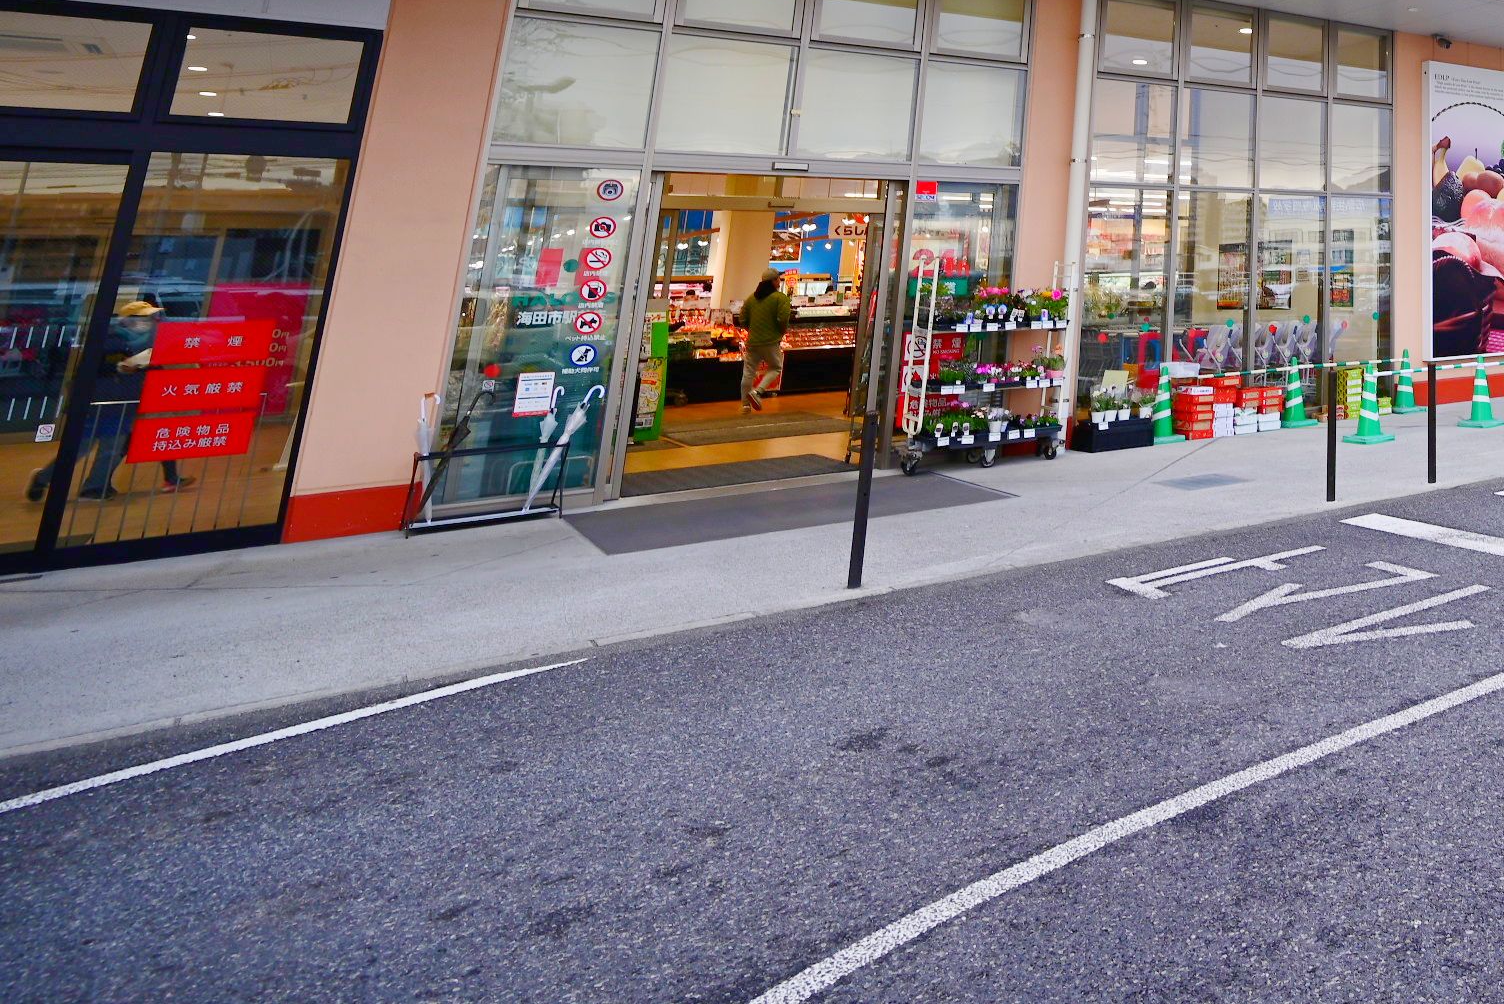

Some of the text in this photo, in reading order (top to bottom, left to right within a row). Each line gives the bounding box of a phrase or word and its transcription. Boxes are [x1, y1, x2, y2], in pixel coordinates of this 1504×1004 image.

[834, 225, 868, 236] くらし
[184, 335, 243, 349] 禁煙
[162, 381, 243, 397] 火気厳禁
[155, 423, 230, 439] 危険物品
[152, 435, 228, 452] 持込み厳禁
